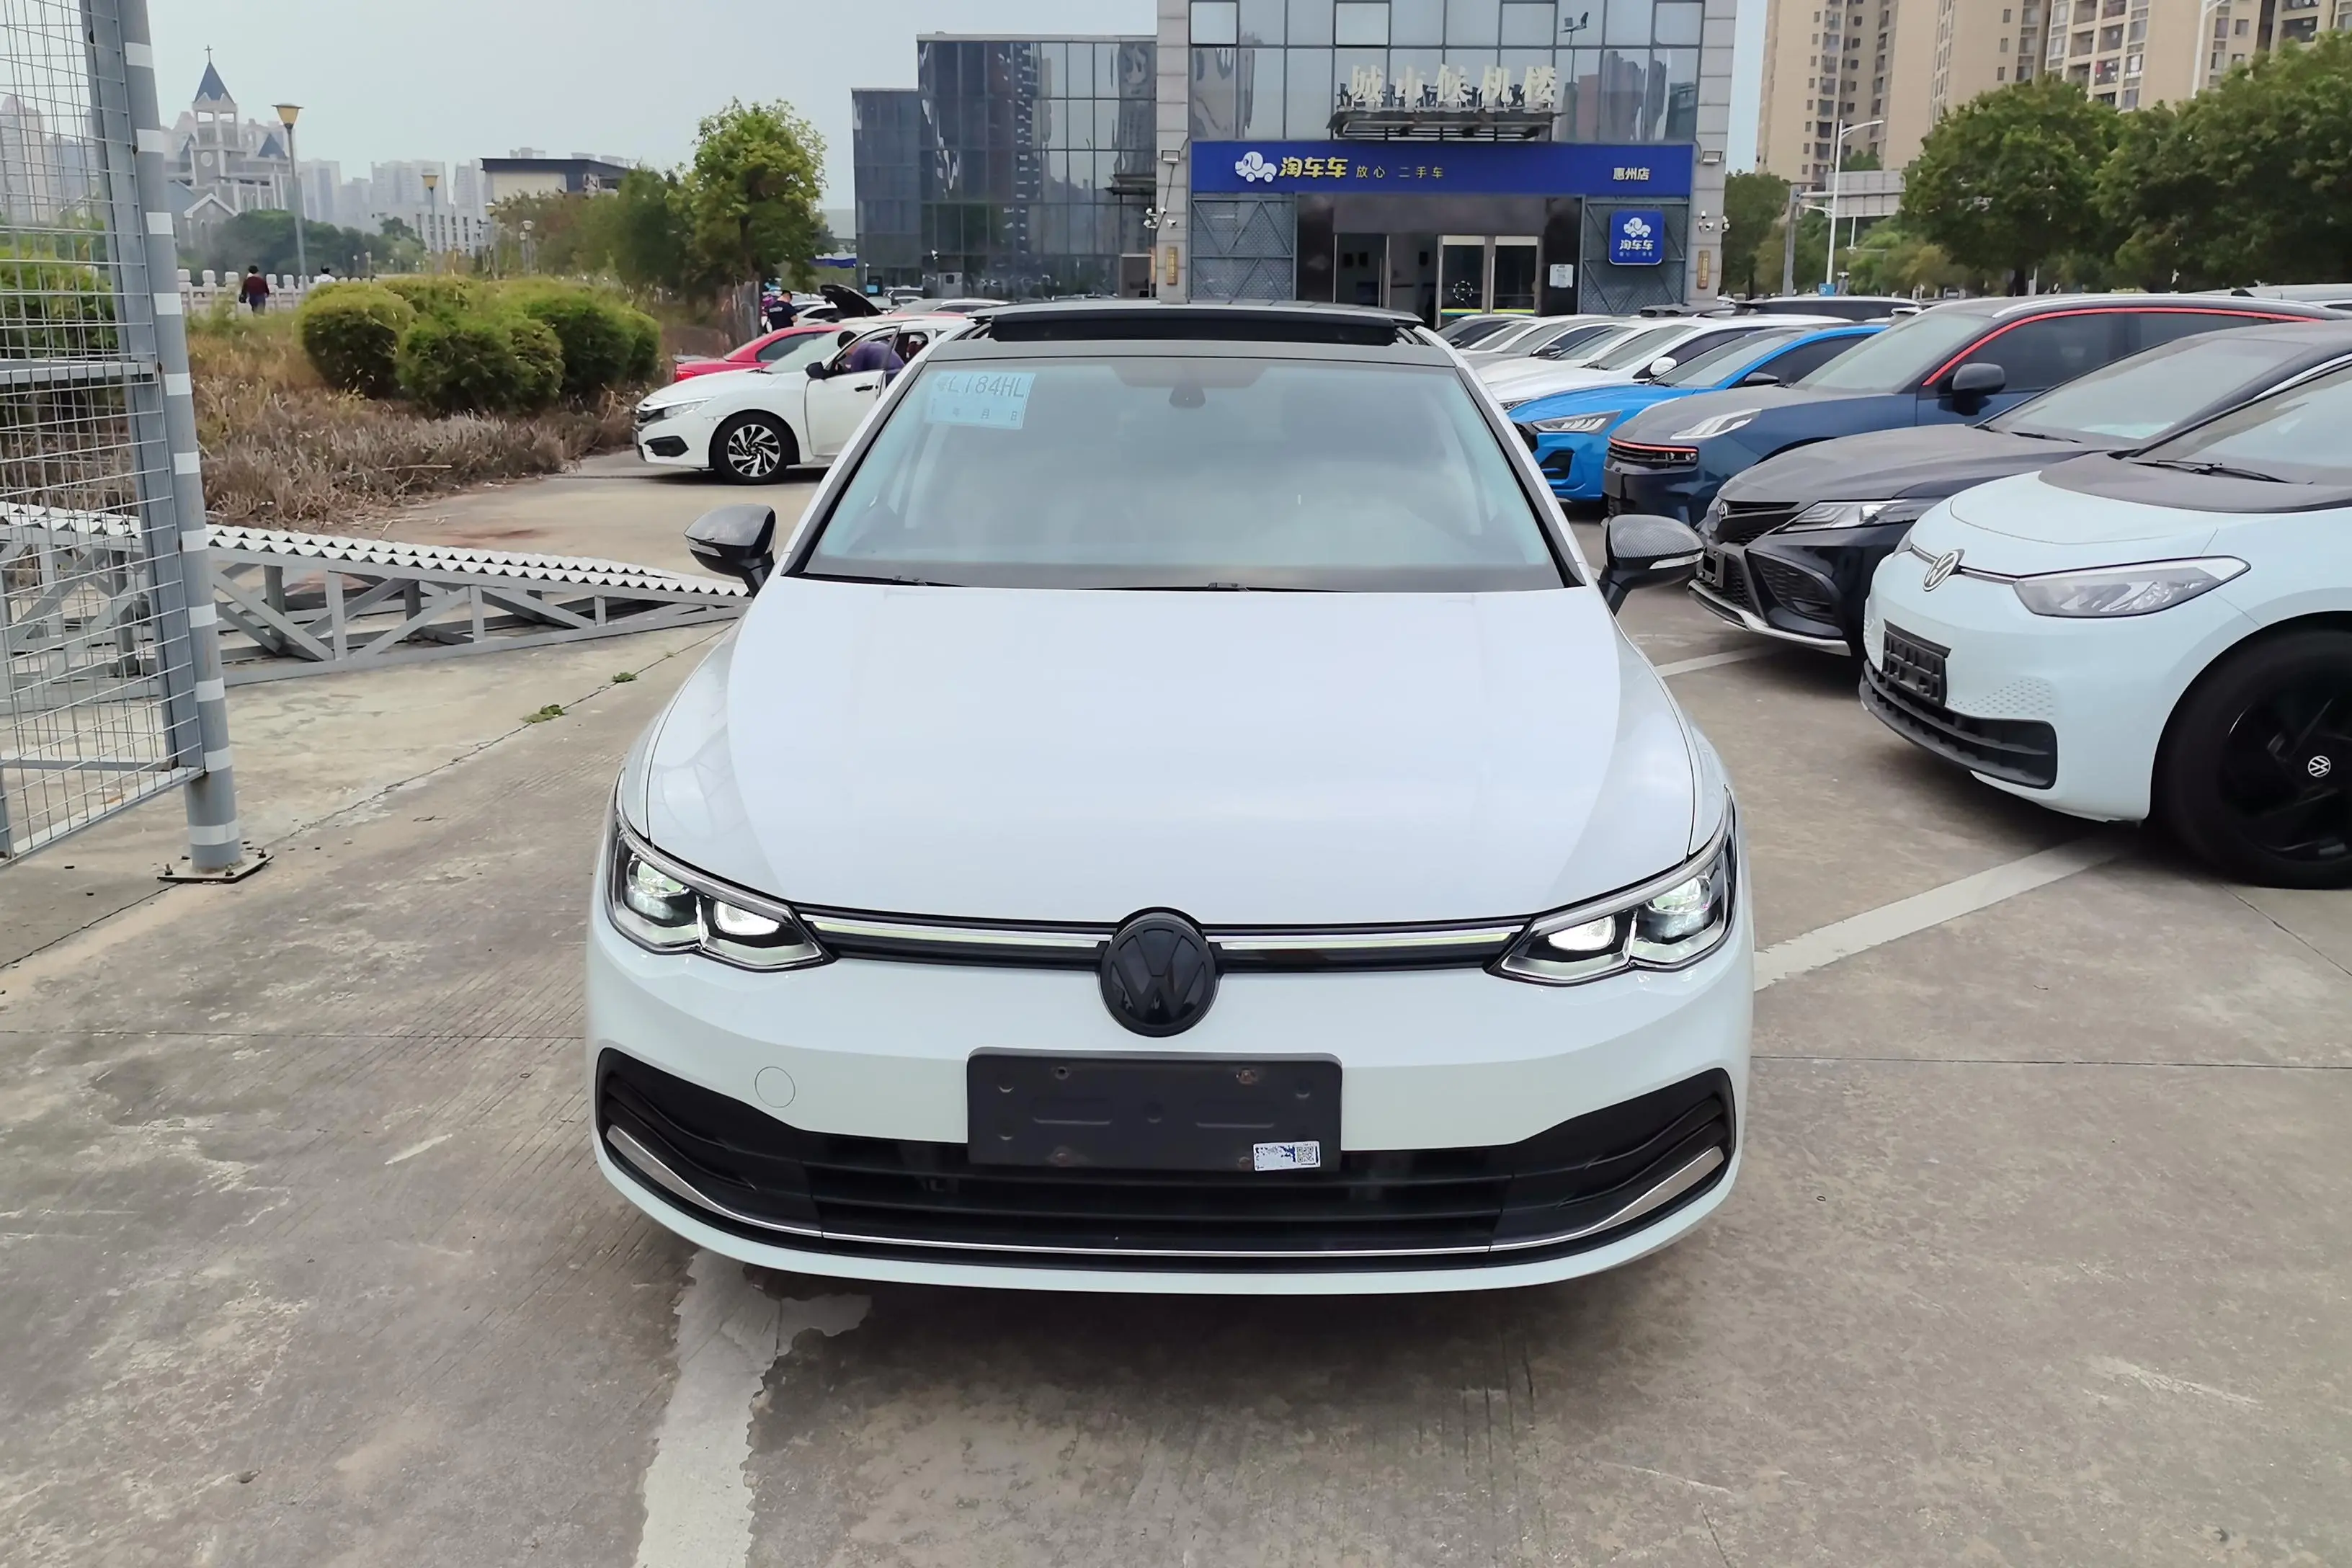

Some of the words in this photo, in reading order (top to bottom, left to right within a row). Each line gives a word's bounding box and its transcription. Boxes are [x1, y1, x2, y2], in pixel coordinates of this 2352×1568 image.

[1279, 156, 1349, 179] 淘车车
[1356, 165, 1386, 179] 放心
[1399, 166, 1444, 179] 二手车
[1613, 166, 1650, 180] 惠州店
[937, 375, 1025, 397] L184HL
